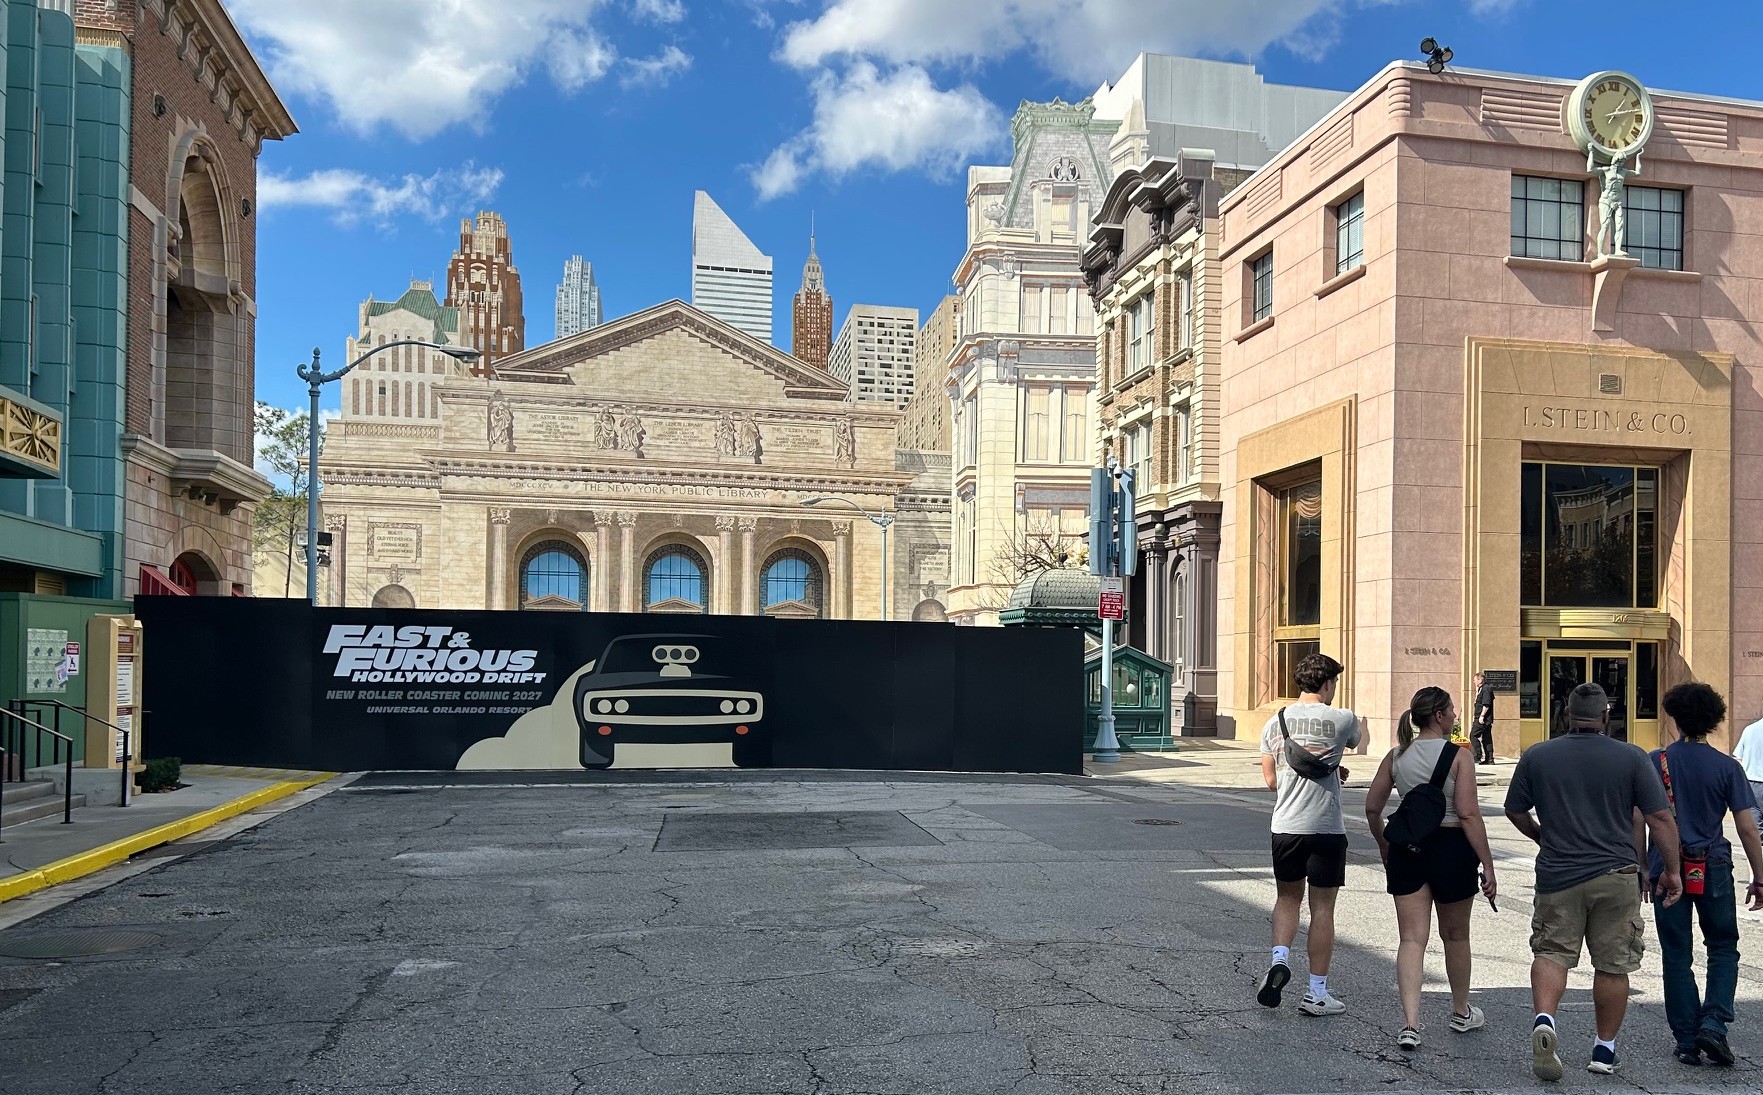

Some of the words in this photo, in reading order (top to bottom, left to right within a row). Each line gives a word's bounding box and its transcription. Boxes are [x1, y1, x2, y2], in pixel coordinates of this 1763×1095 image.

[1626, 412, 1644, 432] &
[1652, 414, 1692, 435] CO.
[583, 483, 603, 491] THE
[638, 486, 666, 494] YORK
[672, 487, 714, 496] PUBLIC
[718, 489, 768, 498] LIBRARY
[322, 624, 452, 653] FAST
[448, 632, 472, 648] &
[333, 648, 538, 676] FURIOUS
[351, 671, 480, 683] HOLLYWOOD
[482, 672, 546, 683] DRIFT
[326, 690, 356, 700] NEW
[358, 690, 404, 700] ROLLER
[406, 691, 460, 700] COASTER
[464, 691, 510, 700] COMING
[512, 692, 542, 700] 2027
